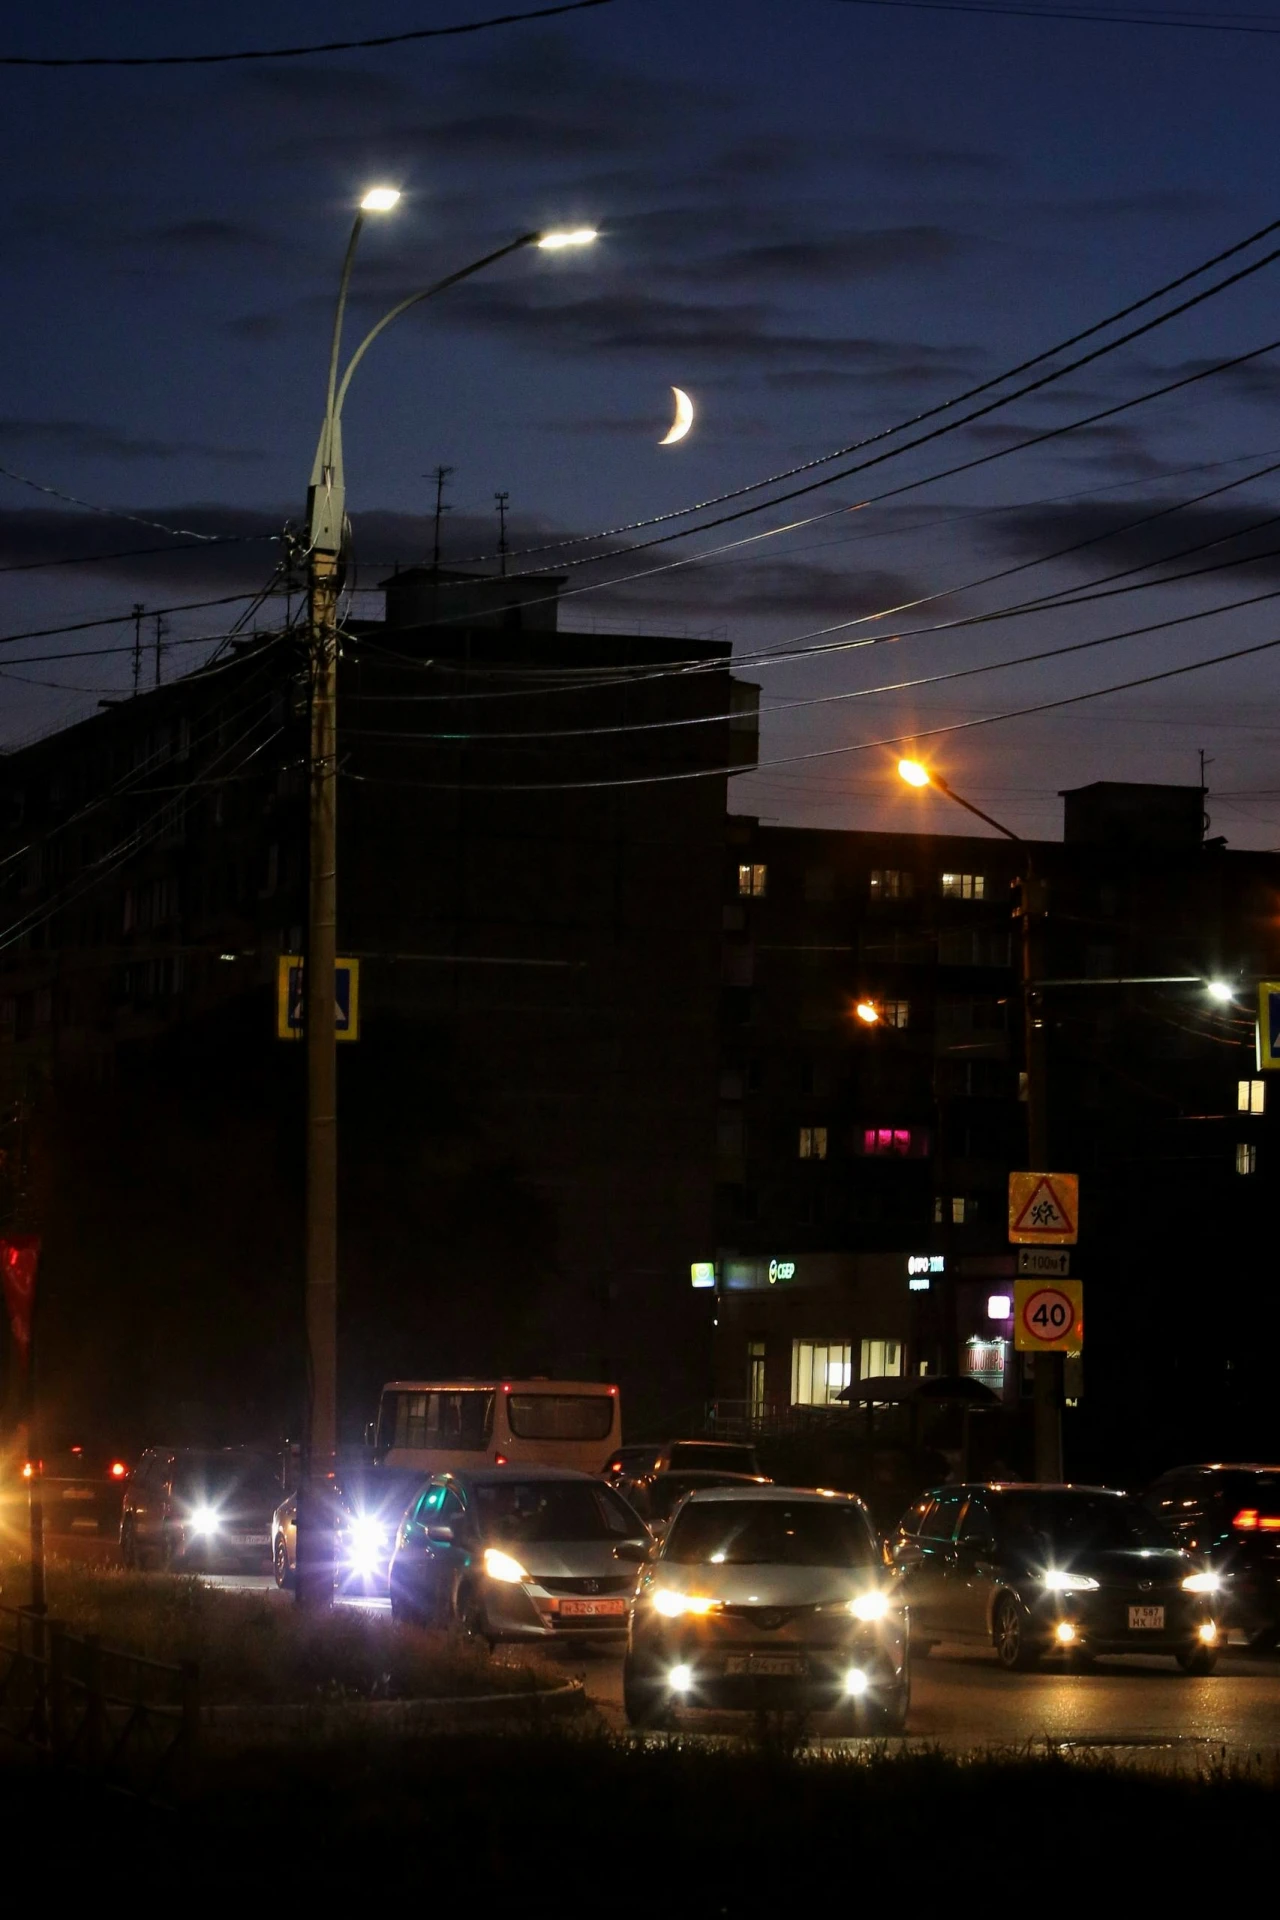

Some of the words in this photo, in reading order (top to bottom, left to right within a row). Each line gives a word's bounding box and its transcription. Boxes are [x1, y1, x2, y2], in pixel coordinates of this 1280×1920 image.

[777, 1262, 795, 1280] СБЕР
[1033, 1254, 1058, 1270] 100м
[1032, 1303, 1066, 1327] 40
